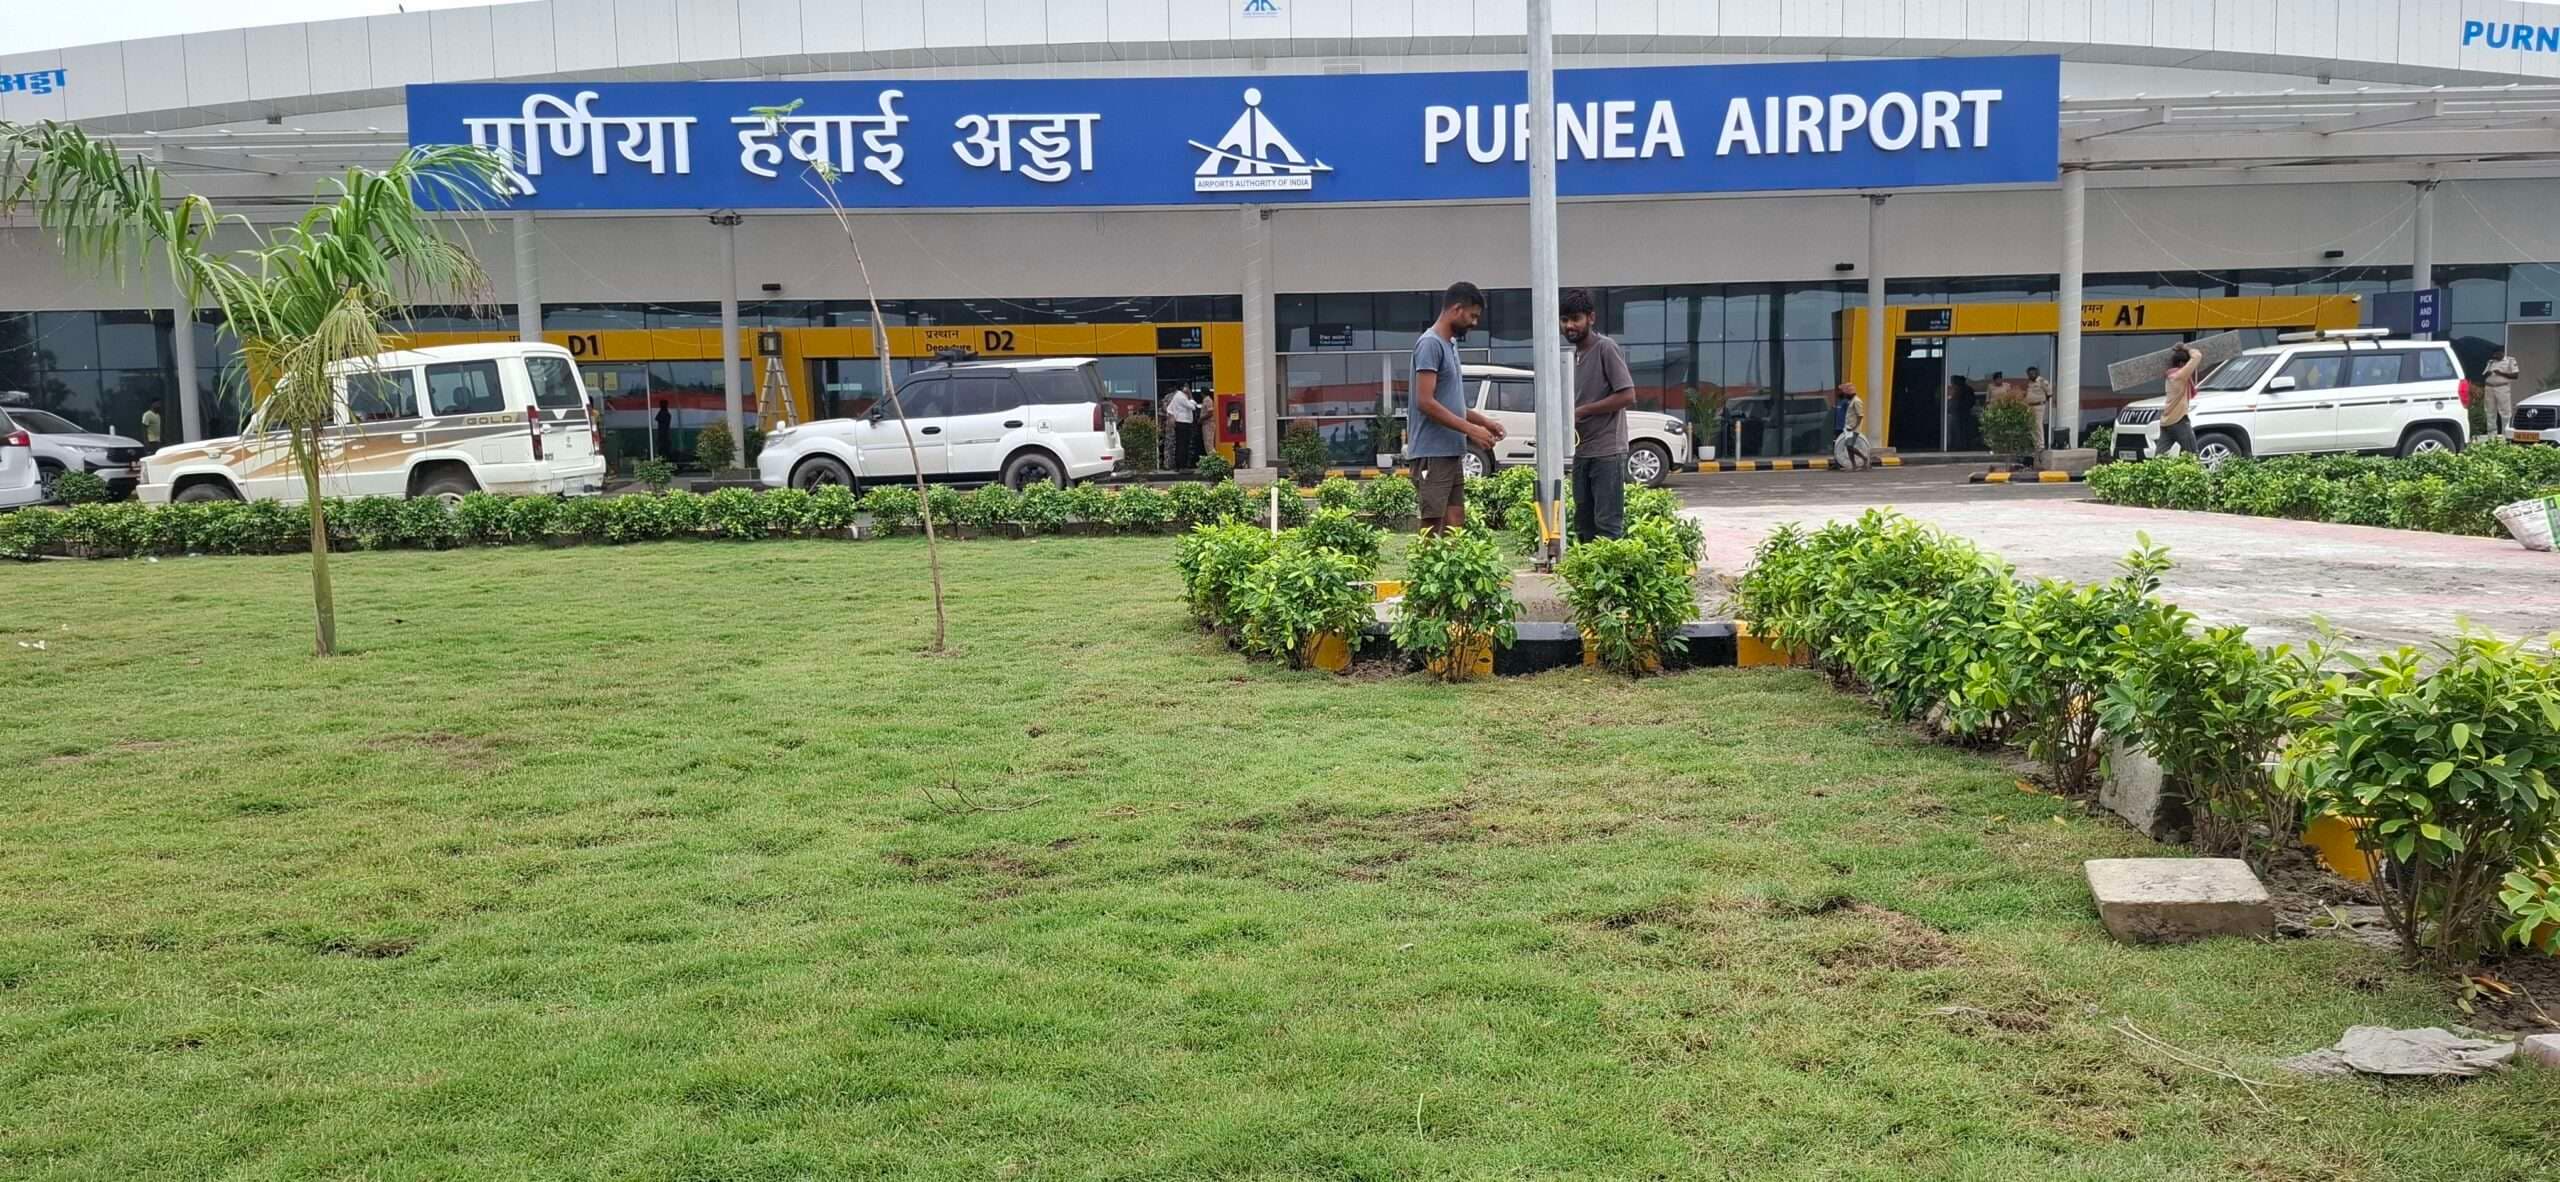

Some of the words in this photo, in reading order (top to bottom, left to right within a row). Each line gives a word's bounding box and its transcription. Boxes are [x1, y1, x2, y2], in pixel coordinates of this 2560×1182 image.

[2462, 20, 2559, 52] PURN
[1715, 88, 2003, 156] AIRPORT
[462, 90, 698, 196] पूर्णिया
[730, 89, 909, 185] हवाई
[952, 112, 1101, 183] अड्डा
[1197, 179, 1234, 188] AIRPORTS
[1235, 179, 1276, 187] AUTHORITY
[1277, 178, 1287, 186] OF
[1289, 178, 1309, 187] INDIA
[2419, 294, 2433, 304] PICK
[2081, 304, 2104, 313] गमन
[2419, 307, 2433, 316] AND
[2114, 304, 2145, 327] A1
[2421, 319, 2431, 329] GO
[925, 330, 960, 340] प्रस्थान
[984, 330, 1015, 351] D2
[568, 334, 599, 357] D1
[466, 415, 513, 426] GOLD
